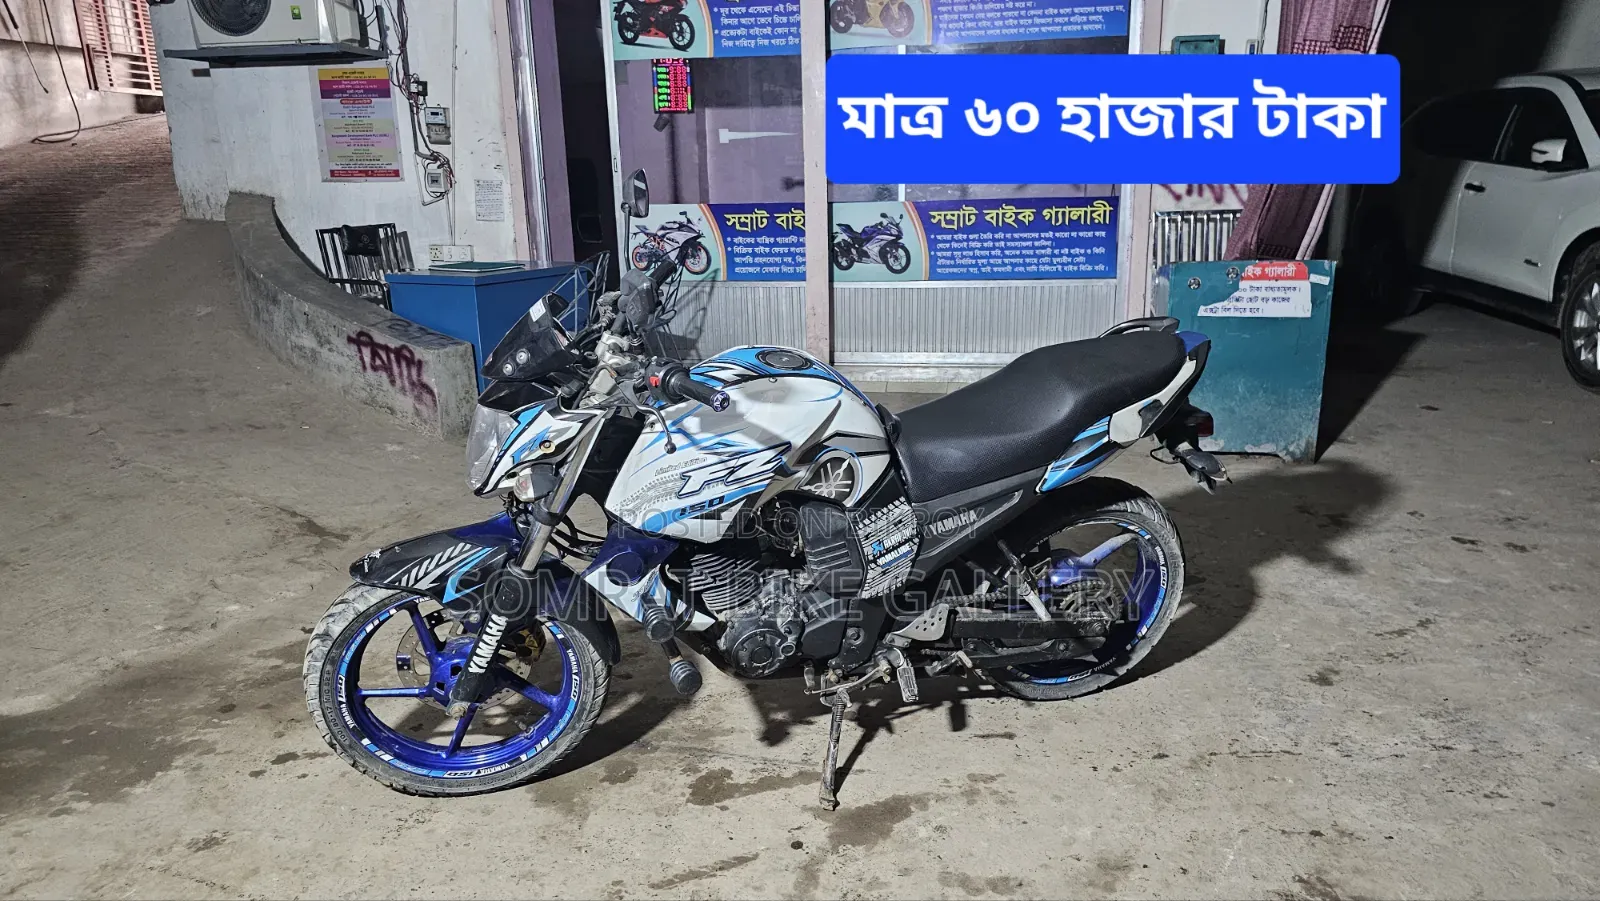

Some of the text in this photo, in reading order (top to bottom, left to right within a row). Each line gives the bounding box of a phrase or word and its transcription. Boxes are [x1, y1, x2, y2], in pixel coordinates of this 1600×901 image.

[774, 4, 784, 13] এই
[757, 38, 769, 46] নিজ
[724, 208, 805, 232] সম্রাট বাই
[929, 200, 1113, 230] সম্রাট বাইক গ্যালারী
[754, 246, 769, 254] বাইক
[994, 241, 1005, 249] তাই
[975, 249, 989, 257] হিসাব
[981, 266, 991, 274] তাই
[1264, 264, 1296, 277] গ্যালারী
[1246, 296, 1259, 304] ছোট
[1271, 296, 1290, 304] কাজের
[1221, 306, 1232, 314] বিল
[1233, 306, 1248, 314] দিতে
[654, 456, 707, 476] Limited Edition
[677, 441, 792, 499] FZ
[680, 495, 725, 516] 150
[929, 510, 978, 535] YAMAHA
[468, 614, 508, 673] YAMAHA
[567, 648, 579, 699] YAMAHA 150
[340, 703, 358, 729] YAMAHA
[477, 763, 511, 775] YAMAHA
